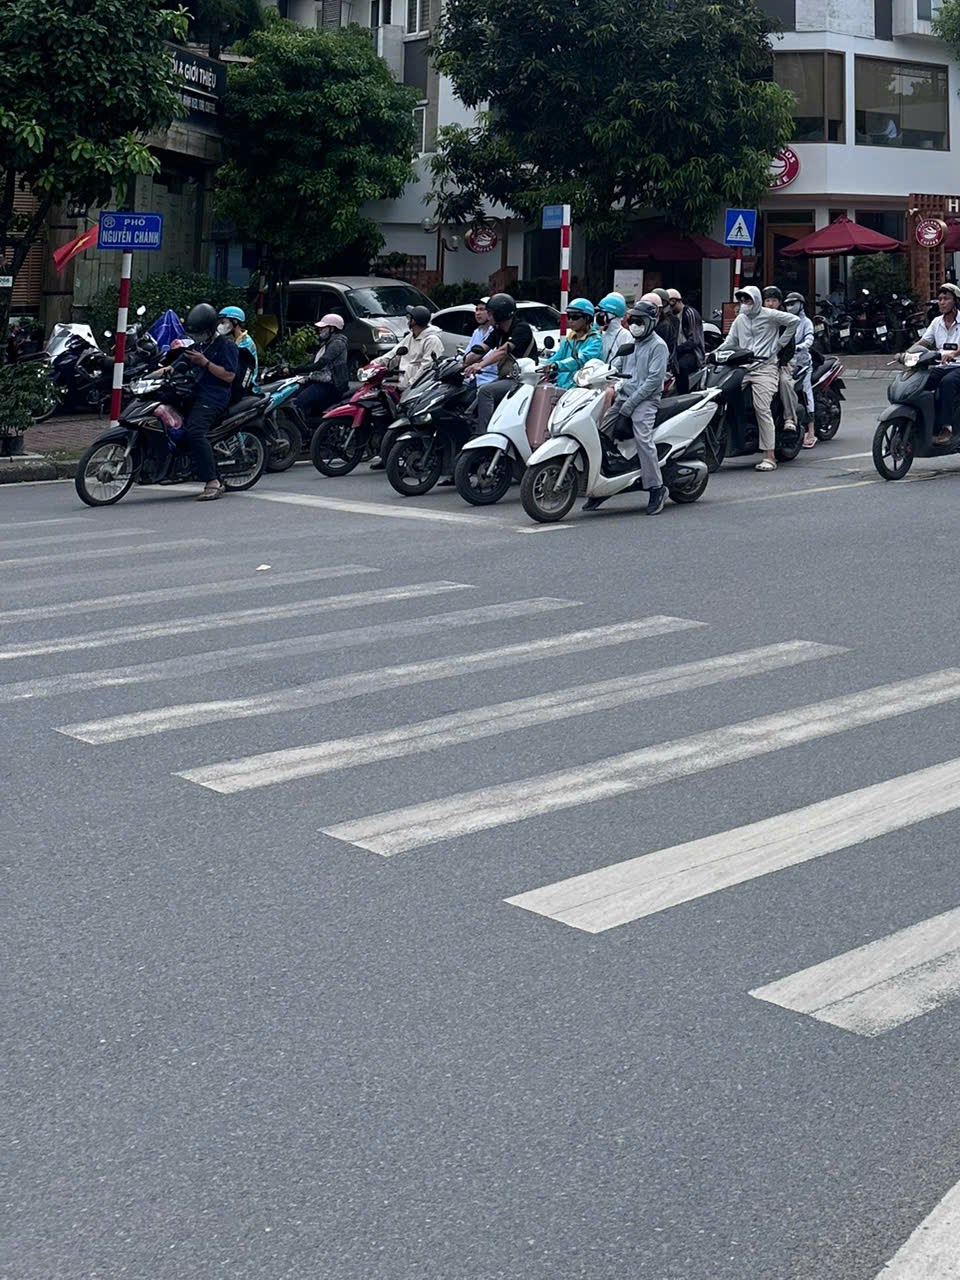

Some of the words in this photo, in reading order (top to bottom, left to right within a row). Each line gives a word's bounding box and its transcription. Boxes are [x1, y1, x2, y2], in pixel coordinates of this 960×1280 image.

[184, 61, 199, 83] GIỚI
[199, 68, 217, 91] THIỆU
[124, 216, 146, 226] PHỐ
[102, 227, 132, 243] NGUYỄN
[133, 228, 160, 244] CHÁNH
